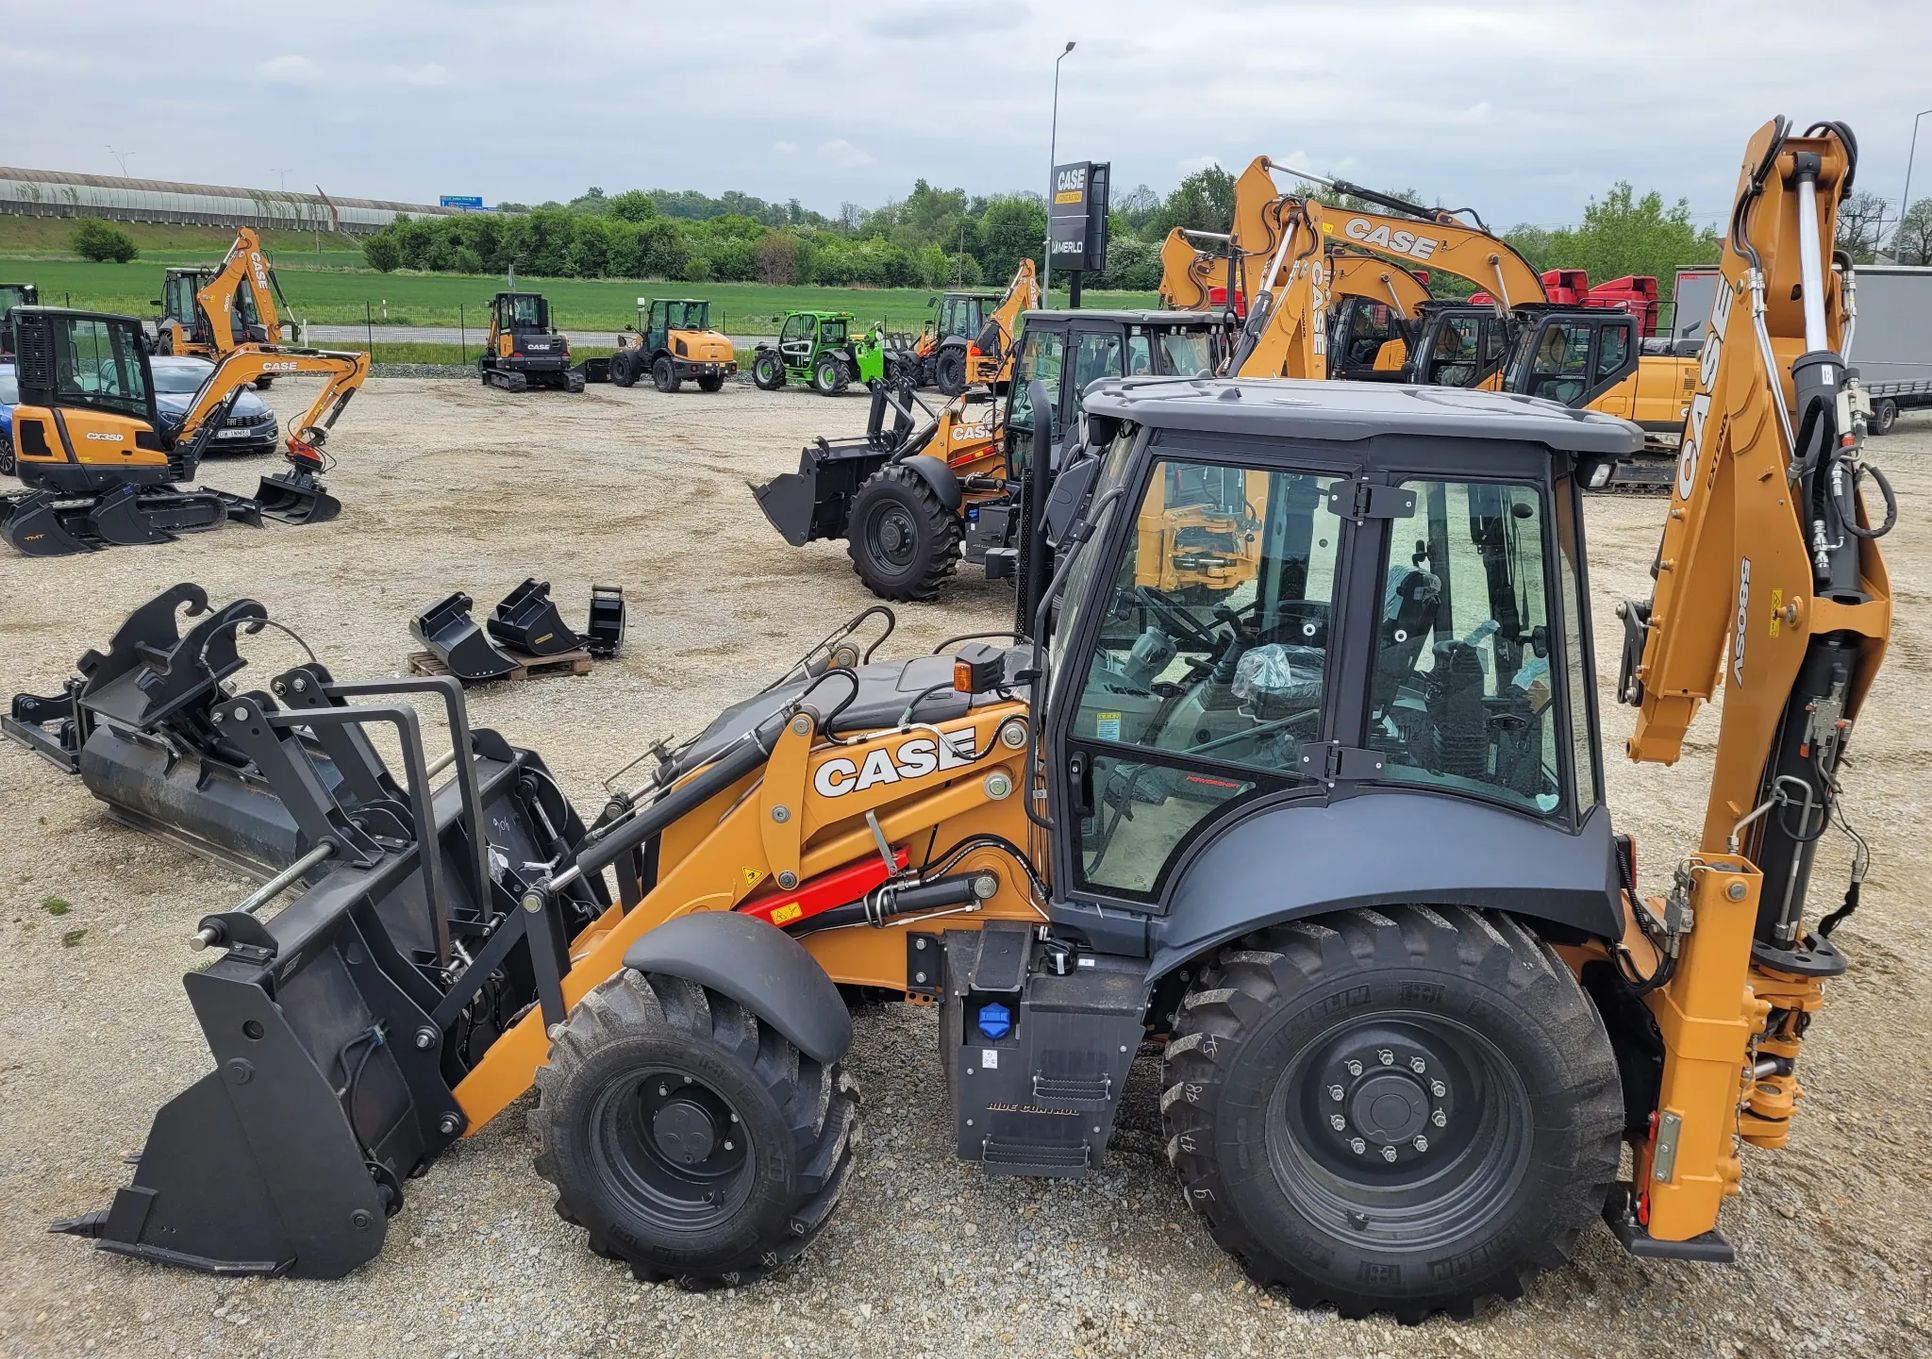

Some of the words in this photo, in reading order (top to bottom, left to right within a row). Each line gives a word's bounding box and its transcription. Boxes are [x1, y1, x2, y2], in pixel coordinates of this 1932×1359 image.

[1057, 168, 1086, 191] CASE
[1058, 241, 1083, 254] MERLO
[1344, 217, 1440, 260] CASE
[251, 252, 268, 289] CASE
[1029, 278, 1038, 309] CASE
[1311, 259, 1326, 355] CASE
[262, 361, 298, 370] CASE
[1678, 271, 1735, 501] CASE
[226, 418, 237, 427] FIAT
[1707, 411, 1729, 490] EXTEND
[1733, 555, 1751, 689] 580SV
[813, 726, 977, 798] CASE
[985, 1101, 1019, 1112] RIDE
[1185, 1083, 1203, 1103] 48
[1180, 1134, 1197, 1153] 47
